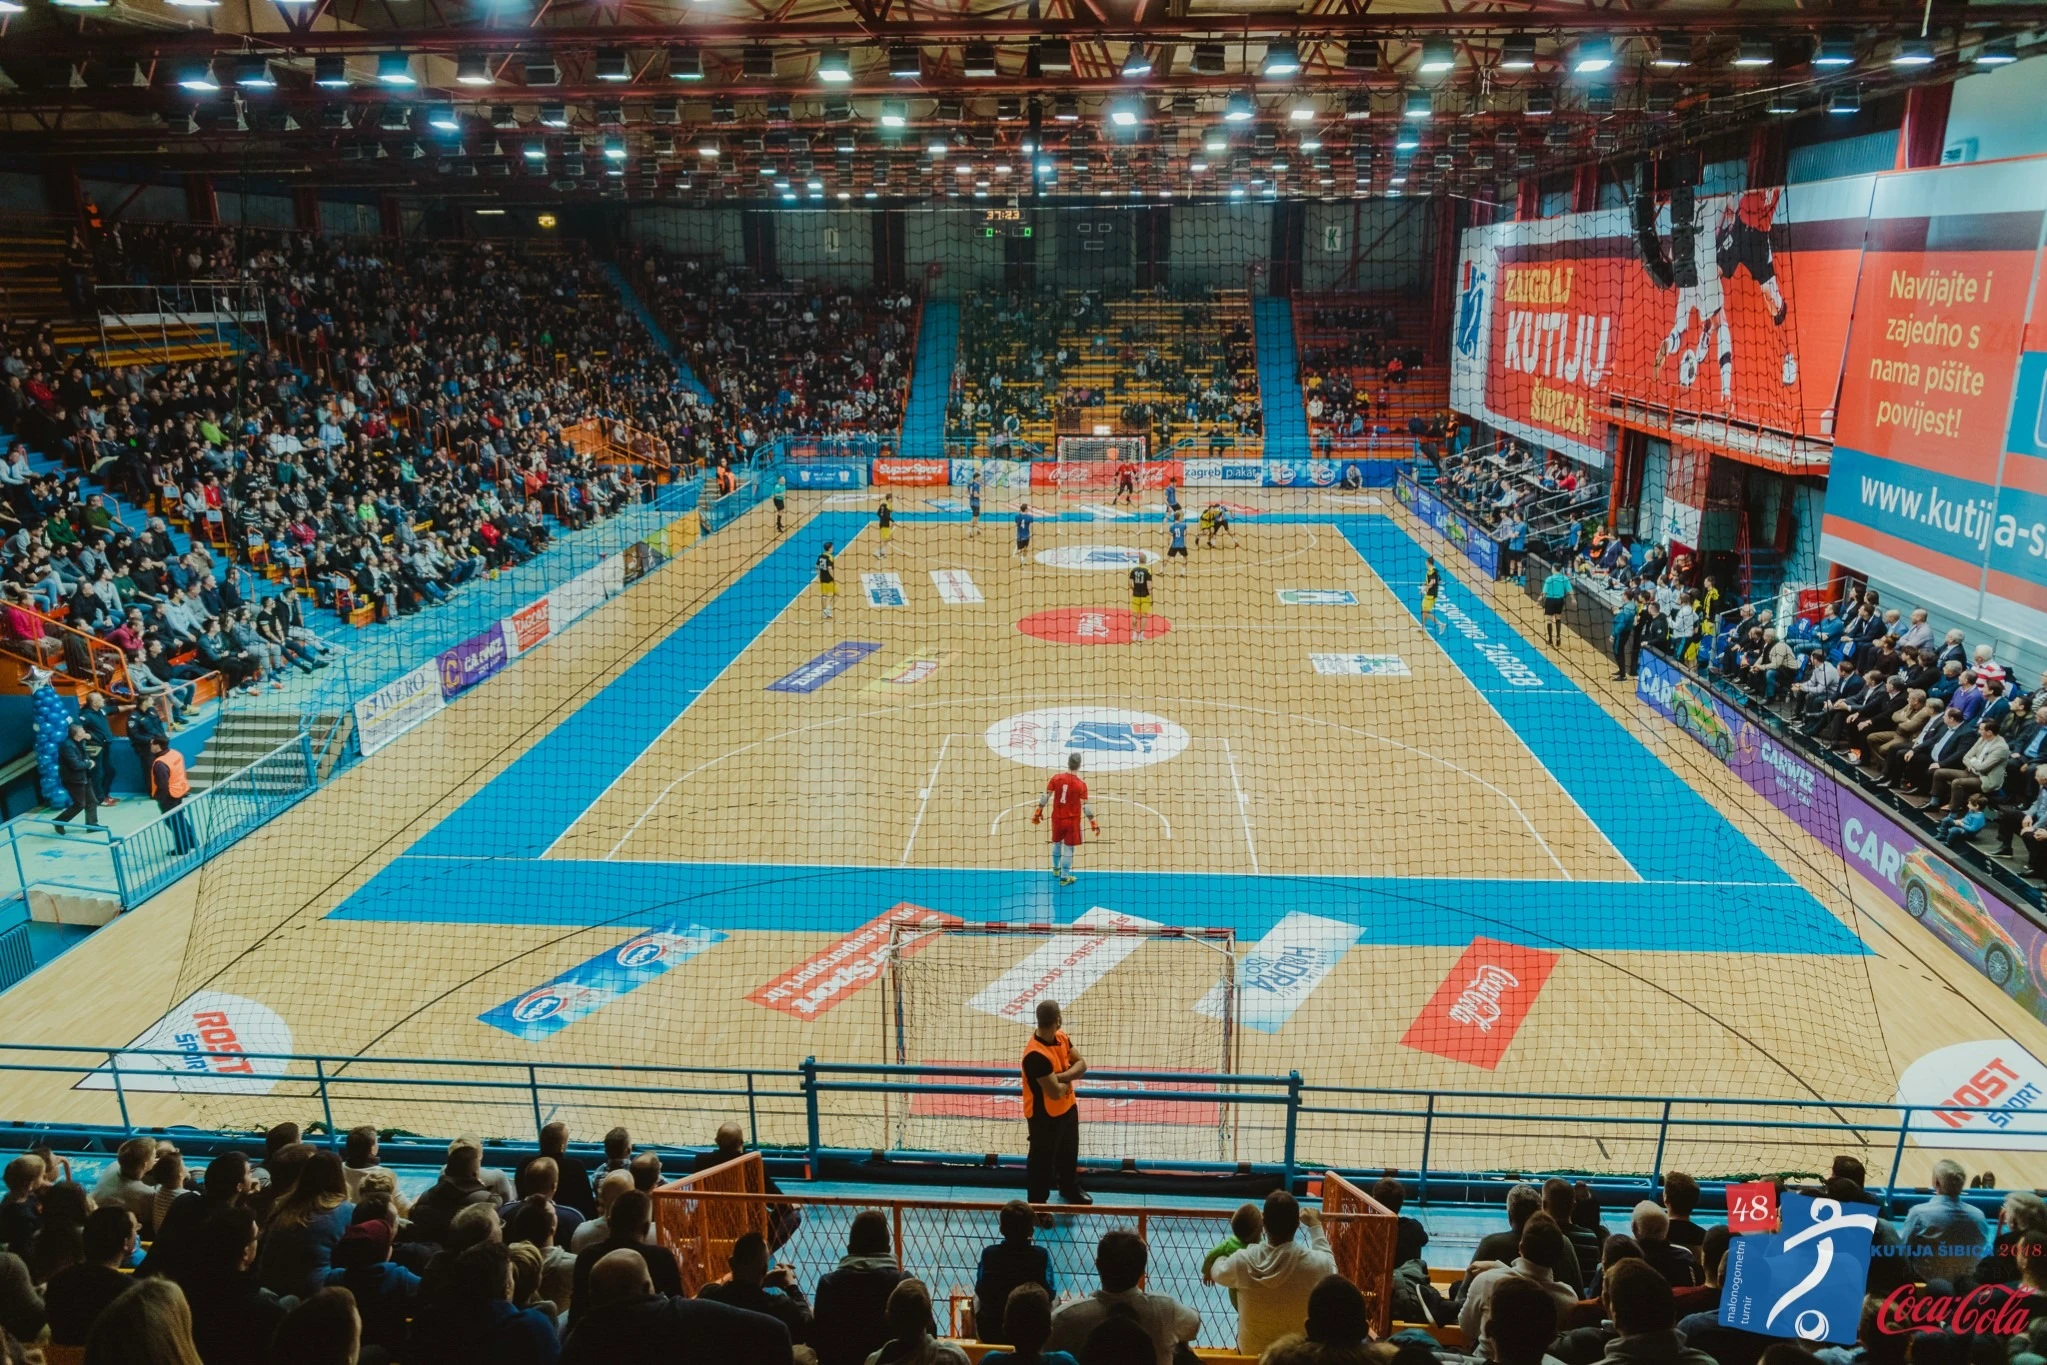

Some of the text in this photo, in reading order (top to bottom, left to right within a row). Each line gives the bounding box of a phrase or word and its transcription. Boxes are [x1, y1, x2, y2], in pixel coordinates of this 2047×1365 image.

[986, 210, 1020, 220] 37:23
[986, 227, 1032, 237] 0 0
[1328, 228, 1337, 249] K
[1504, 267, 1574, 304] ZAIGRAJ
[1889, 270, 1993, 307] Navijajte i
[1505, 311, 1610, 388] KUTIJU
[1886, 314, 1962, 348] zajedno
[1967, 324, 1981, 350] s
[1870, 357, 1985, 397] nama pišite
[1876, 399, 1963, 438] povijest!
[1185, 467, 1221, 479] zagreb
[1861, 475, 2047, 559] www.kutija-s
[1473, 643, 1544, 686] ZAGREB
[1761, 742, 1815, 794] CARWIZ
[1060, 784, 1068, 804] 1
[1001, 967, 1065, 1016] novosti
[1448, 964, 1519, 1034] Coca-Cola
[192, 1011, 254, 1074] ROST
[1931, 1057, 2020, 1129] ROST
